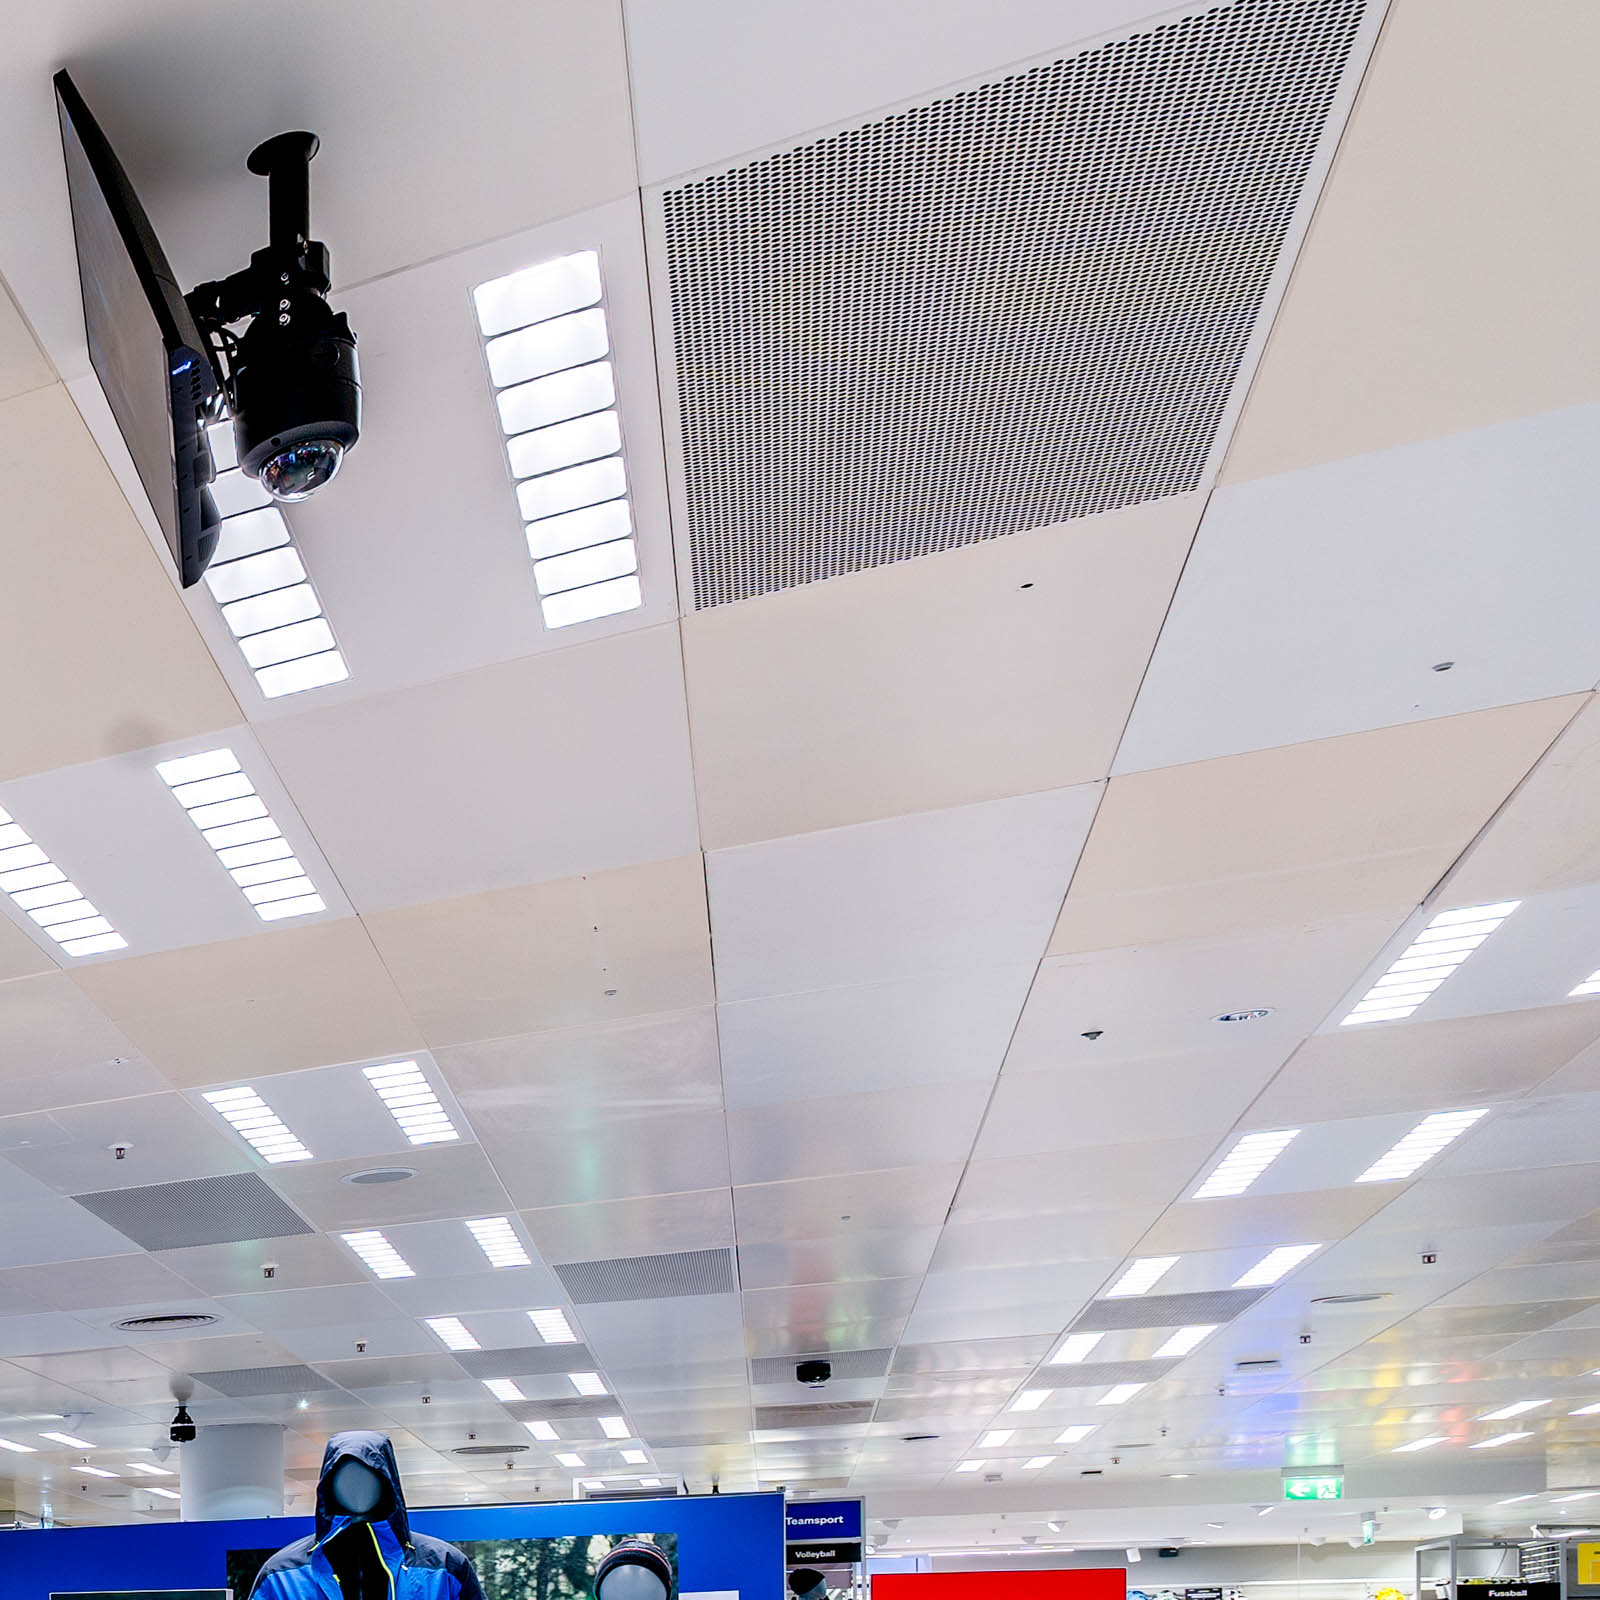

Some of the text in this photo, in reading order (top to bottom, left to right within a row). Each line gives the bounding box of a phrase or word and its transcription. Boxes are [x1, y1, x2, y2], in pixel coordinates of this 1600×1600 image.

[785, 1515, 844, 1526] Teamsport
[795, 1550, 836, 1559] Volleyball
[1488, 1589, 1528, 1597] Fussball
